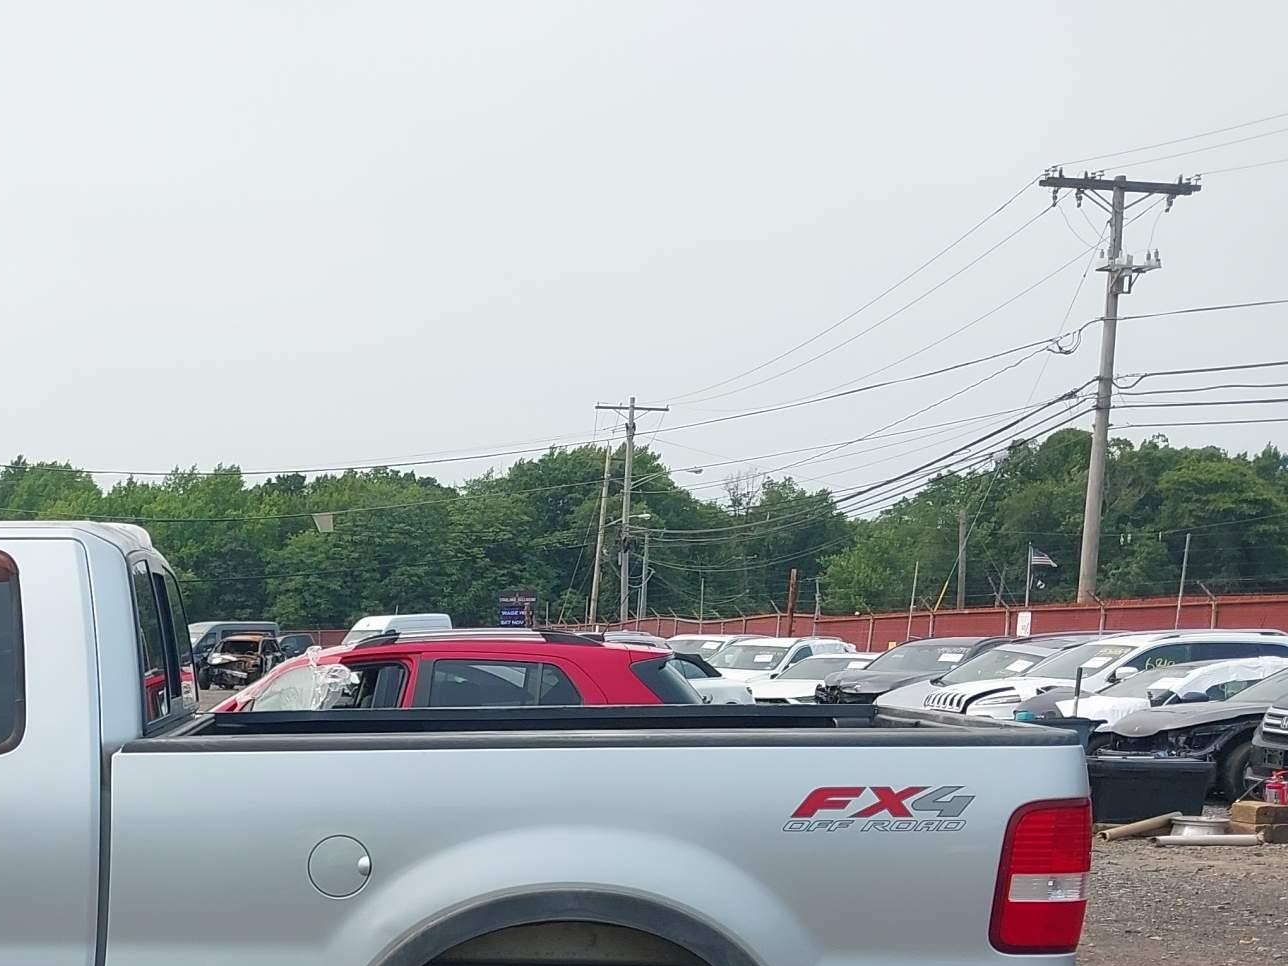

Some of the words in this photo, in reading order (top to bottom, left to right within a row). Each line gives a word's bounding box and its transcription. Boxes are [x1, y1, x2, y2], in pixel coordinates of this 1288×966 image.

[790, 786, 975, 818] FX4
[782, 819, 855, 832] OFF
[860, 819, 967, 832] ROAD
